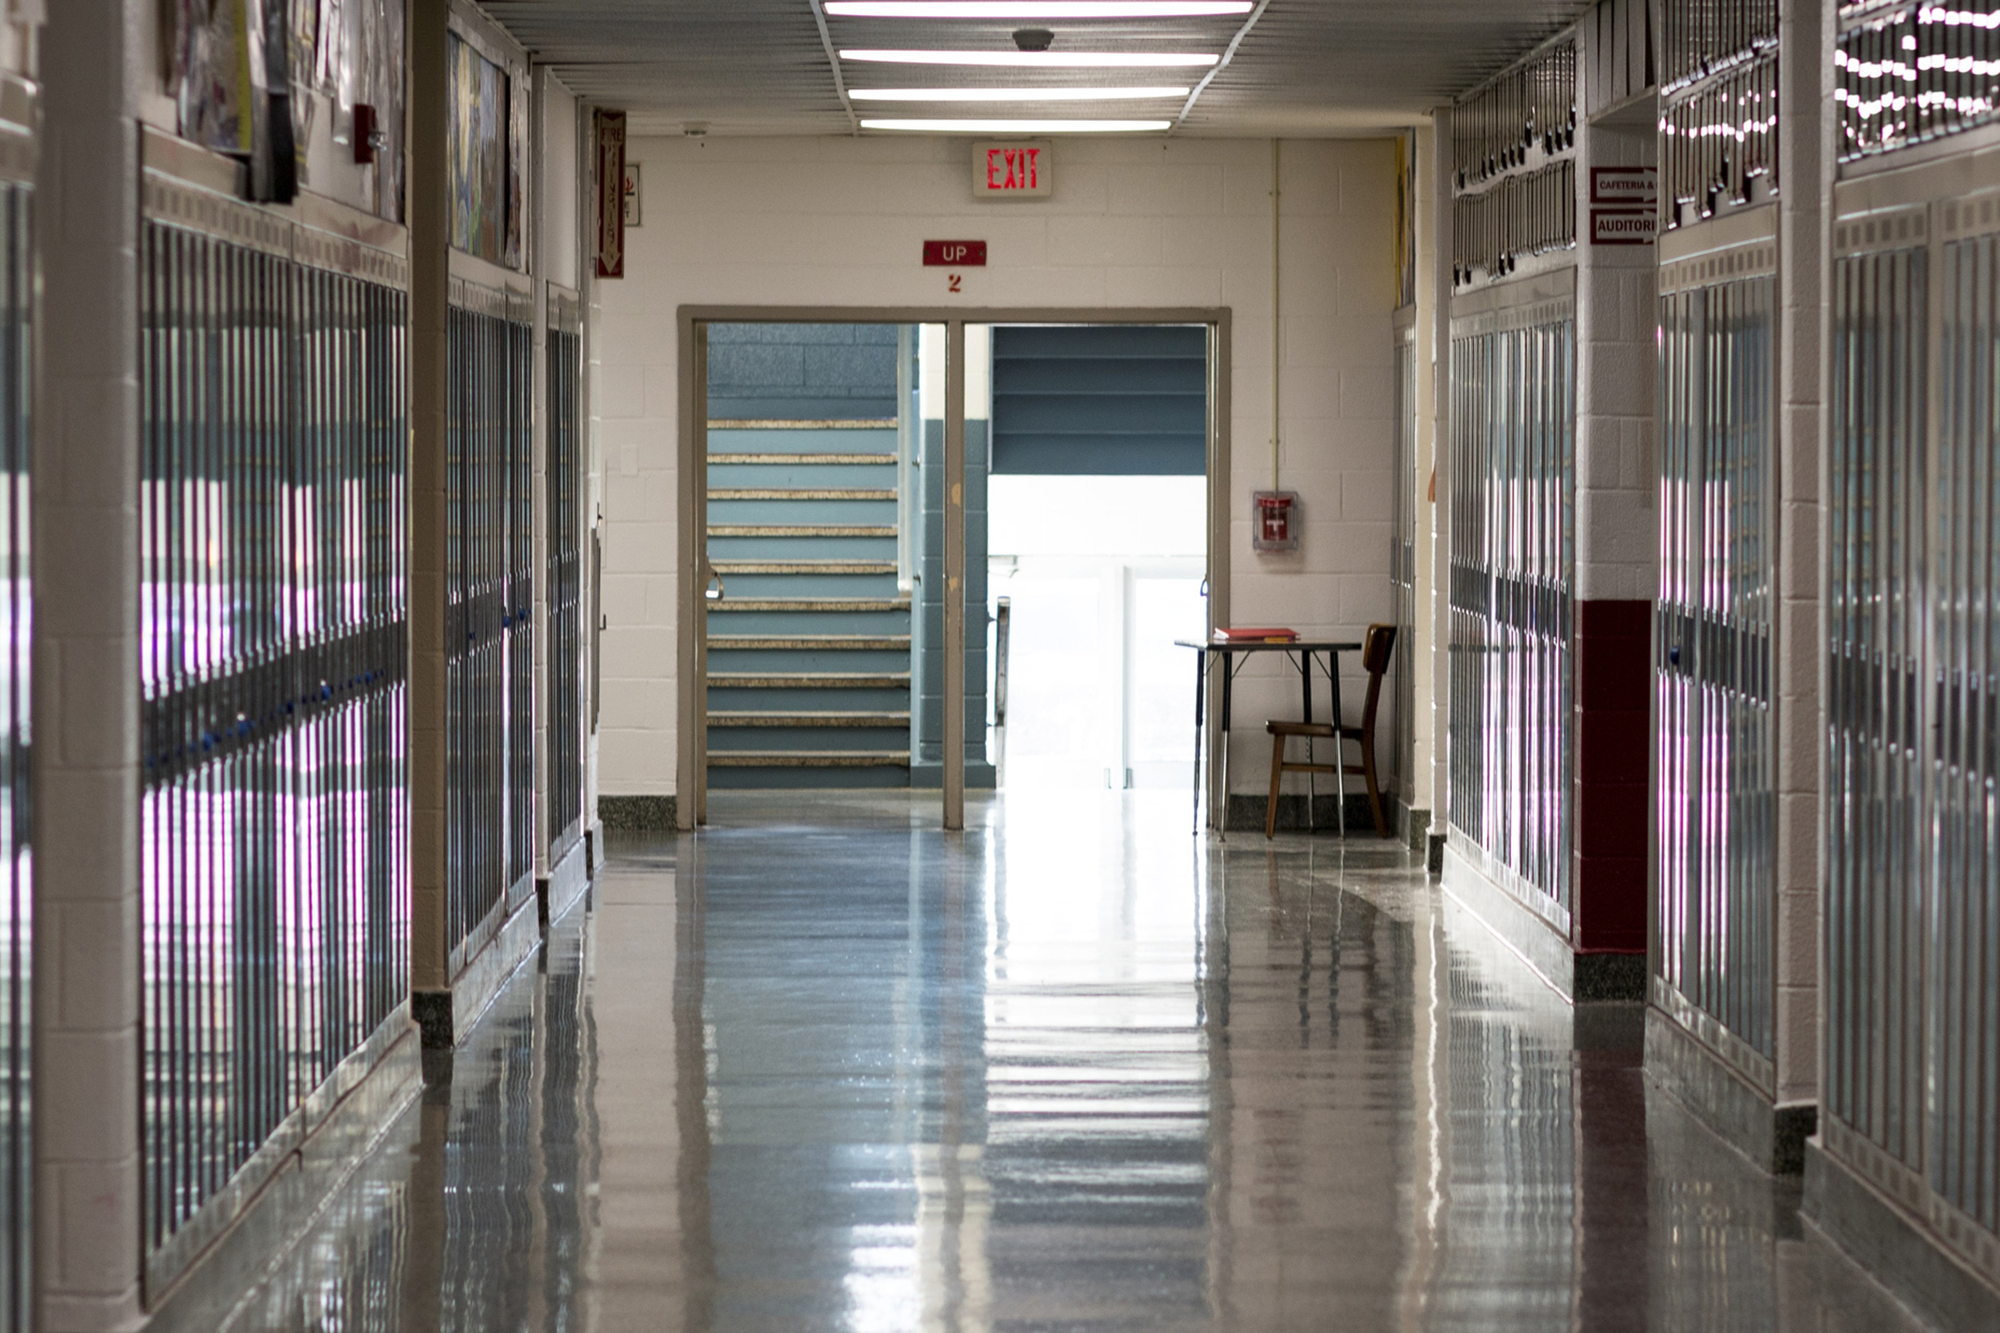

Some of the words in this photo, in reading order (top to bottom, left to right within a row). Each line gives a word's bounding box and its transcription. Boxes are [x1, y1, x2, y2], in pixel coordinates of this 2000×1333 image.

[601, 127, 622, 141] FRE
[987, 148, 1040, 189] EXIT
[1600, 181, 1645, 190] CAFETERIA
[1647, 181, 1655, 190] &
[1598, 220, 1655, 232] AUDITORI
[942, 246, 967, 261] UP
[948, 274, 961, 293] 2
